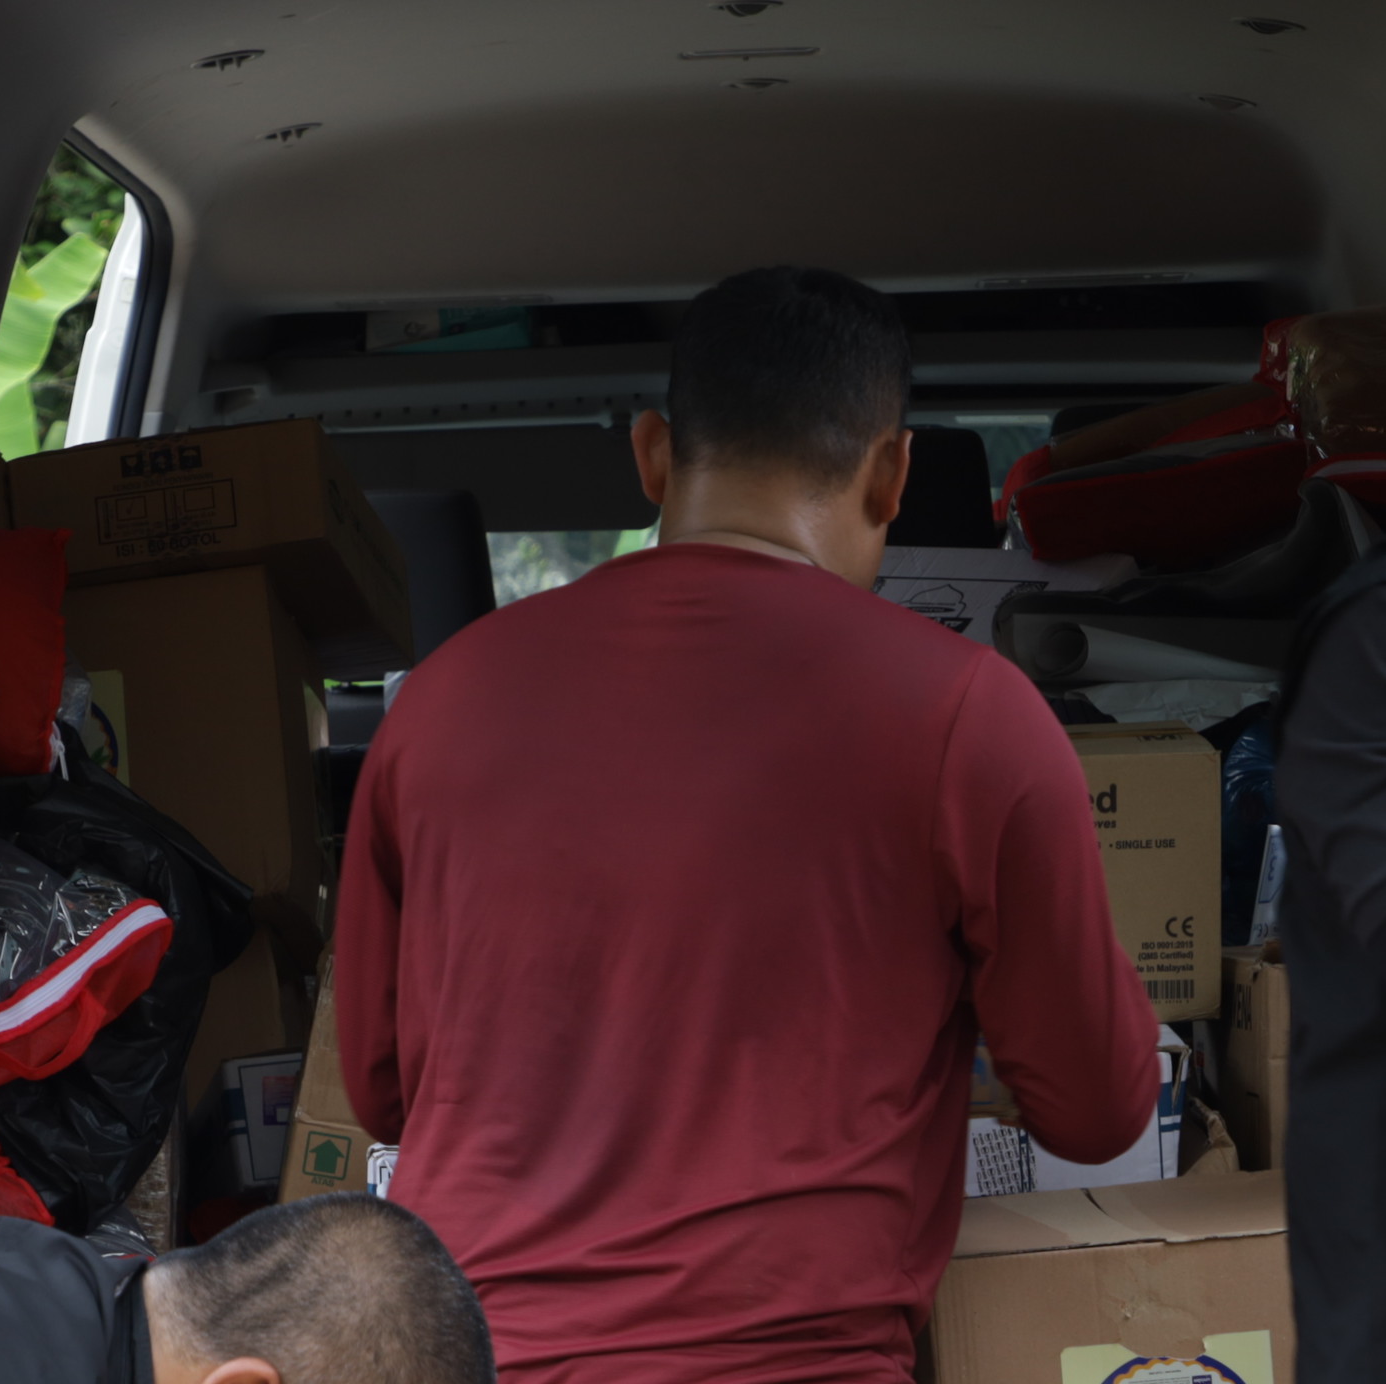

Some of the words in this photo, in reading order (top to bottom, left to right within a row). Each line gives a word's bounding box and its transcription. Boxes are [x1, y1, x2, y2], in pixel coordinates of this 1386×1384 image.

[116, 544, 134, 557] ISI
[170, 533, 221, 549] BOTOL
[1115, 839, 1152, 850] SINGLE
[1155, 838, 1175, 849] USE
[1157, 964, 1194, 973] Malaysia
